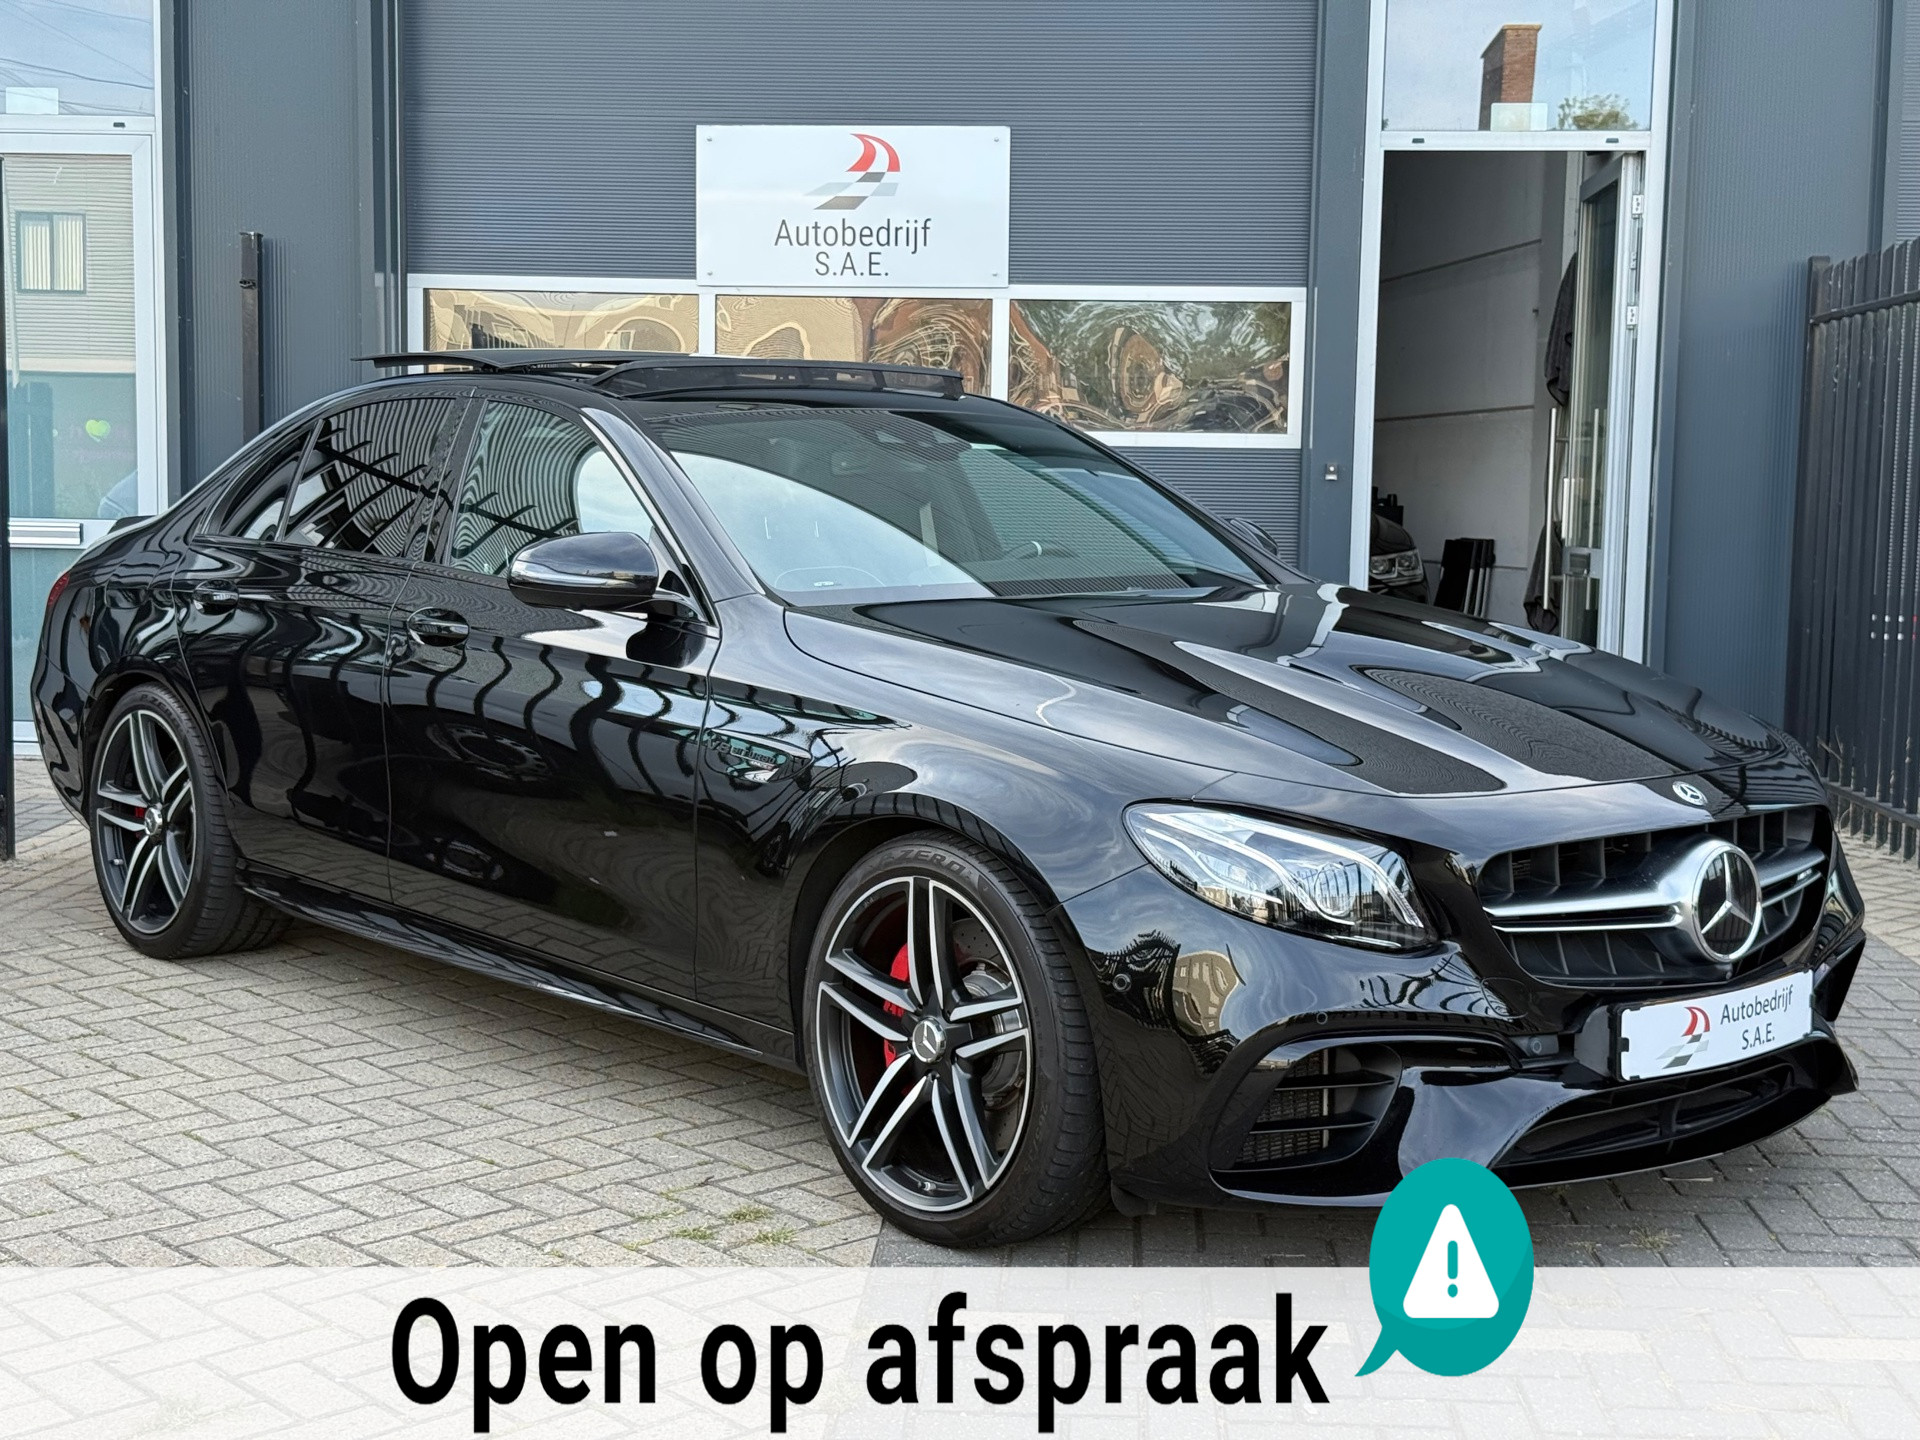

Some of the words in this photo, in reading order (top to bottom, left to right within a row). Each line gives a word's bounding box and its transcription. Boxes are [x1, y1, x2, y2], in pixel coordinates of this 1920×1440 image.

[774, 218, 932, 254] Autobedrijf
[815, 251, 889, 276] S.A.E.
[899, 850, 966, 875] ZERO
[1720, 984, 1794, 1026] Autobedrijf
[1741, 1022, 1775, 1050] S.A.E.
